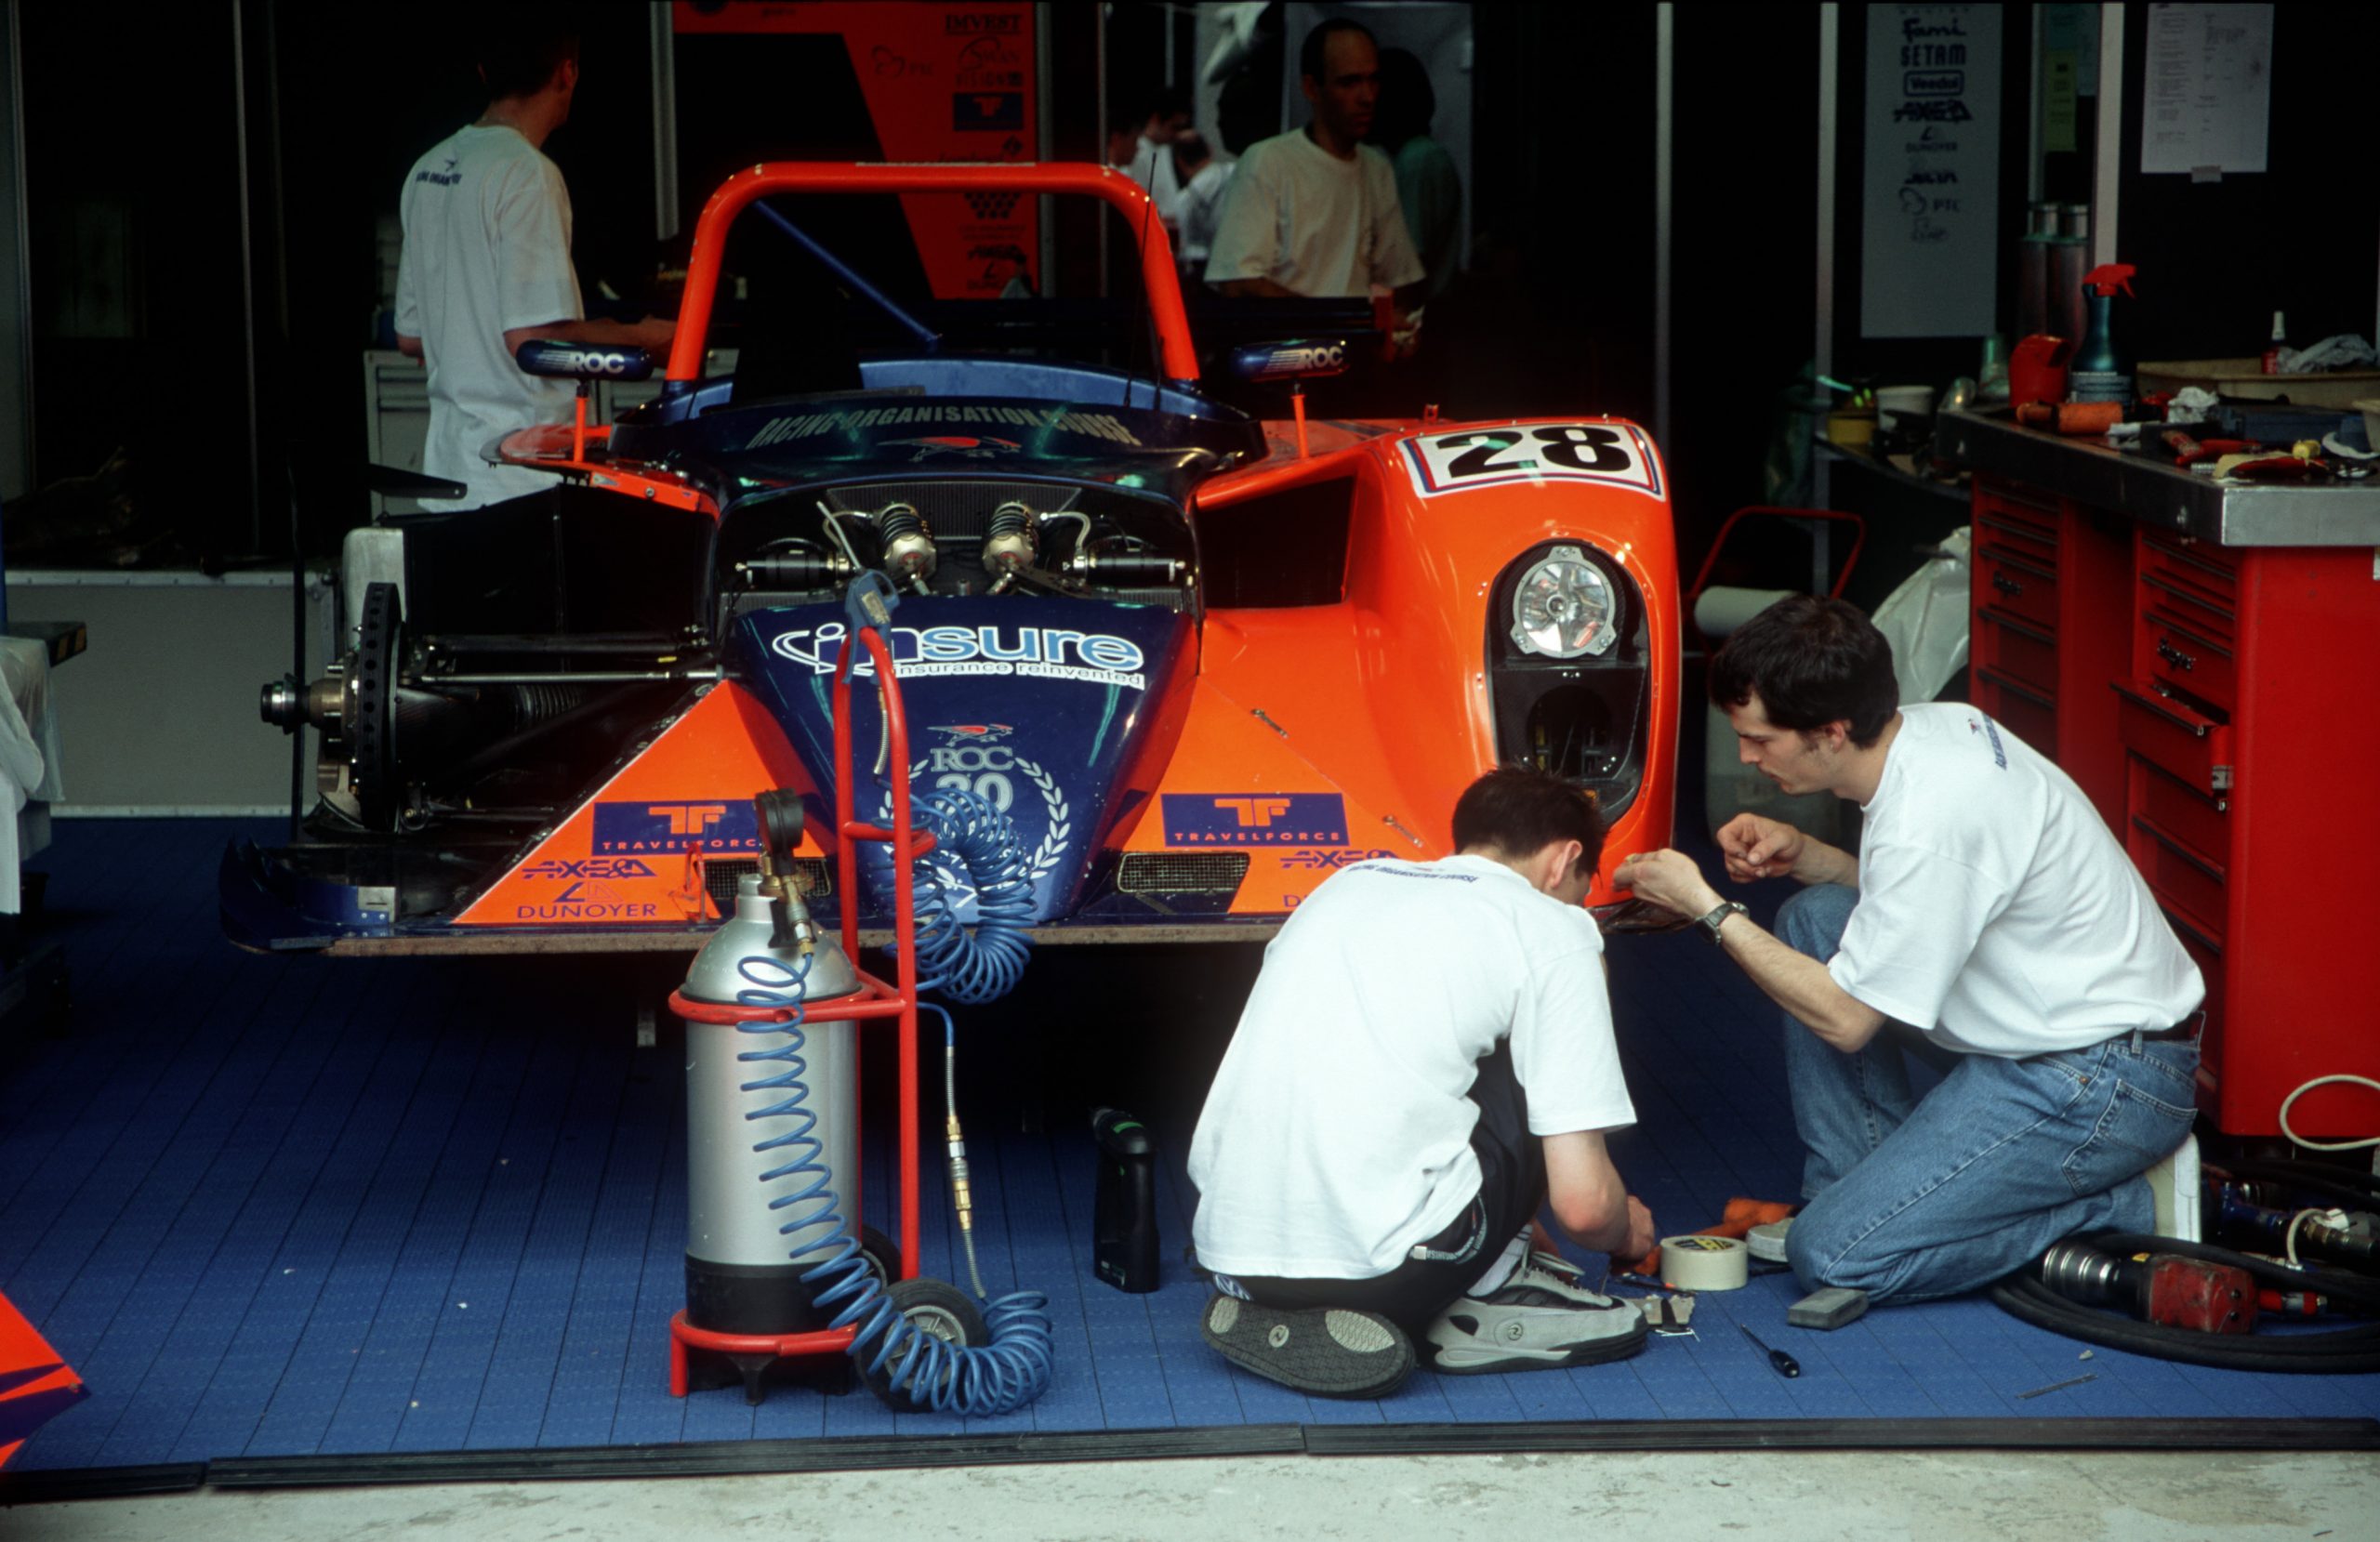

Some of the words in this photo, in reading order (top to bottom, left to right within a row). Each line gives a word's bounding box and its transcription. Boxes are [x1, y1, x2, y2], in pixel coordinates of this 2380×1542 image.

[1900, 45, 1966, 66] SETAM
[565, 351, 625, 374] ROC
[1295, 346, 1342, 369] ROC
[839, 406, 1044, 430] ORGANISATION
[1435, 426, 1633, 479] 28
[1017, 663, 1143, 686] reinvented
[930, 746, 1014, 772] ROC
[1174, 832, 1341, 841] TRAVELFORCE
[516, 904, 656, 919] DUNOYER
